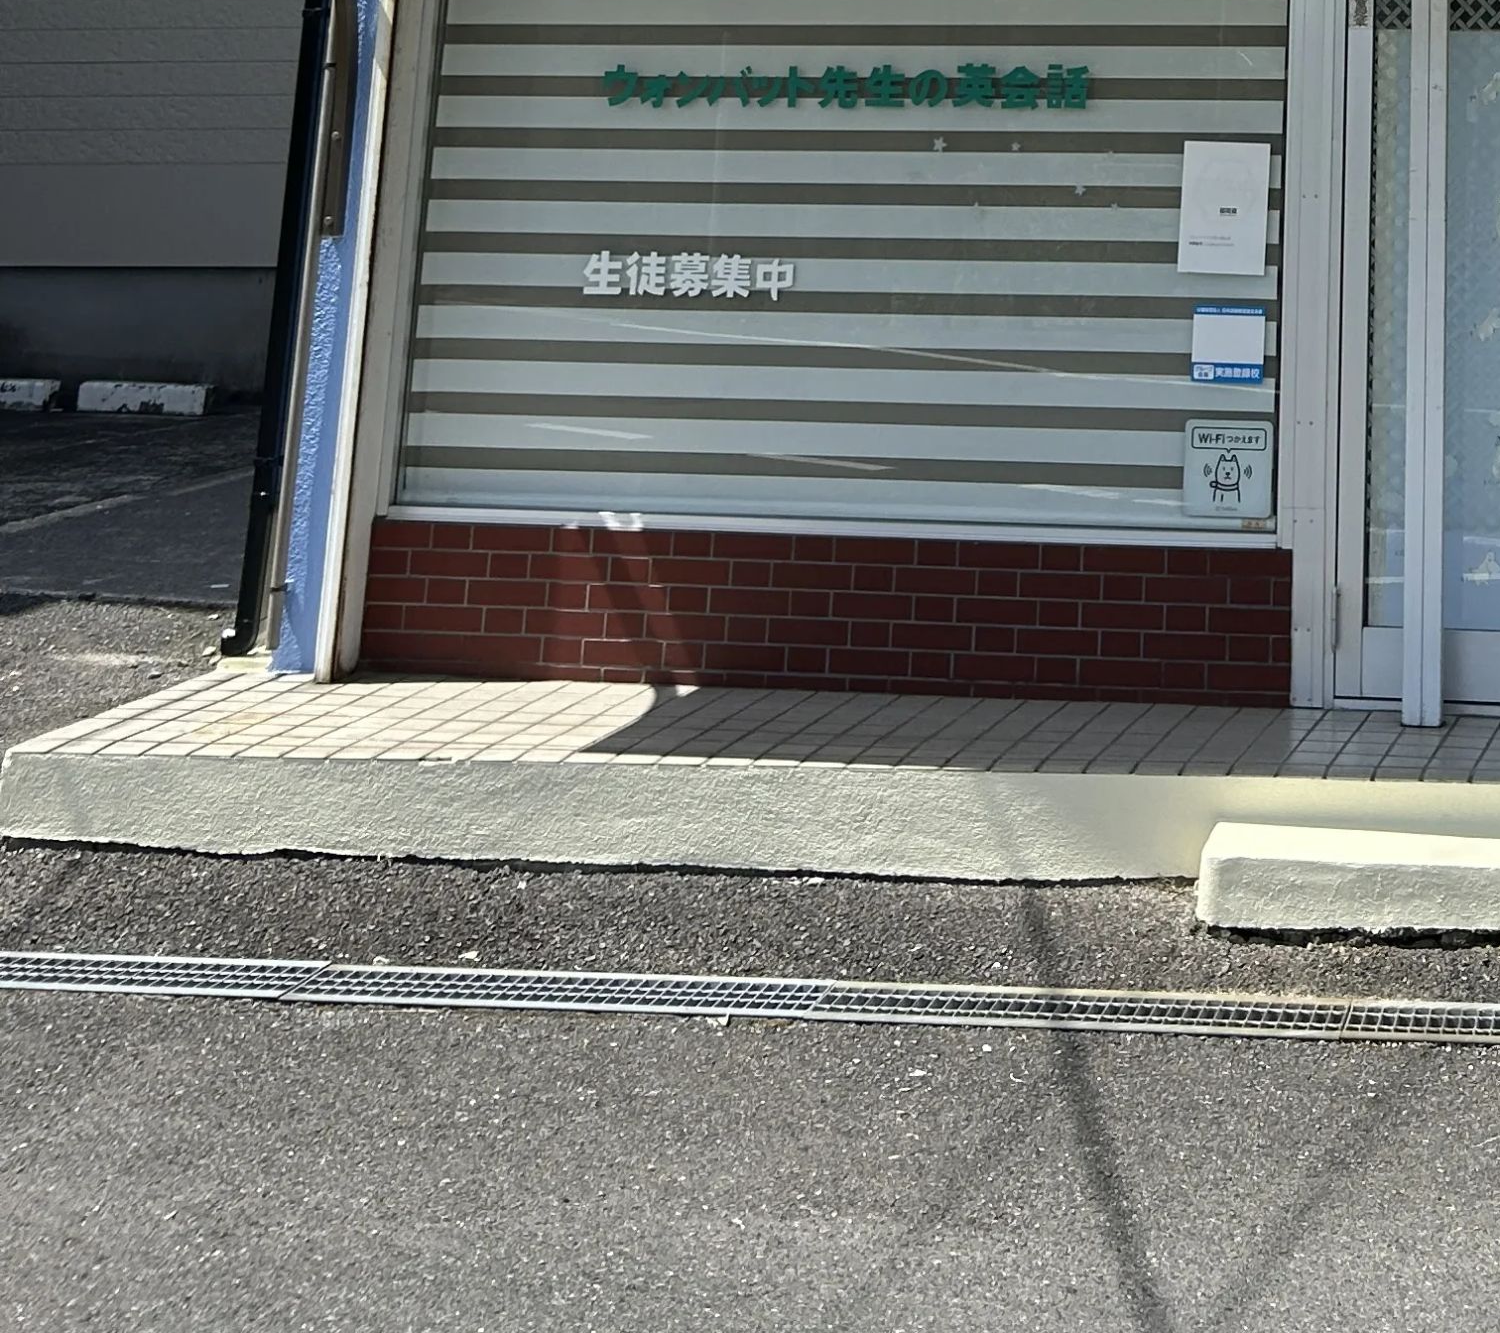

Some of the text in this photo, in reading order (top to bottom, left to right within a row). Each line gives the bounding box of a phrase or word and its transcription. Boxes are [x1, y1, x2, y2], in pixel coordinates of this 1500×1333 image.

[602, 62, 1091, 110] ウォンバット先生の英会話
[582, 250, 796, 301] 生徒募集中
